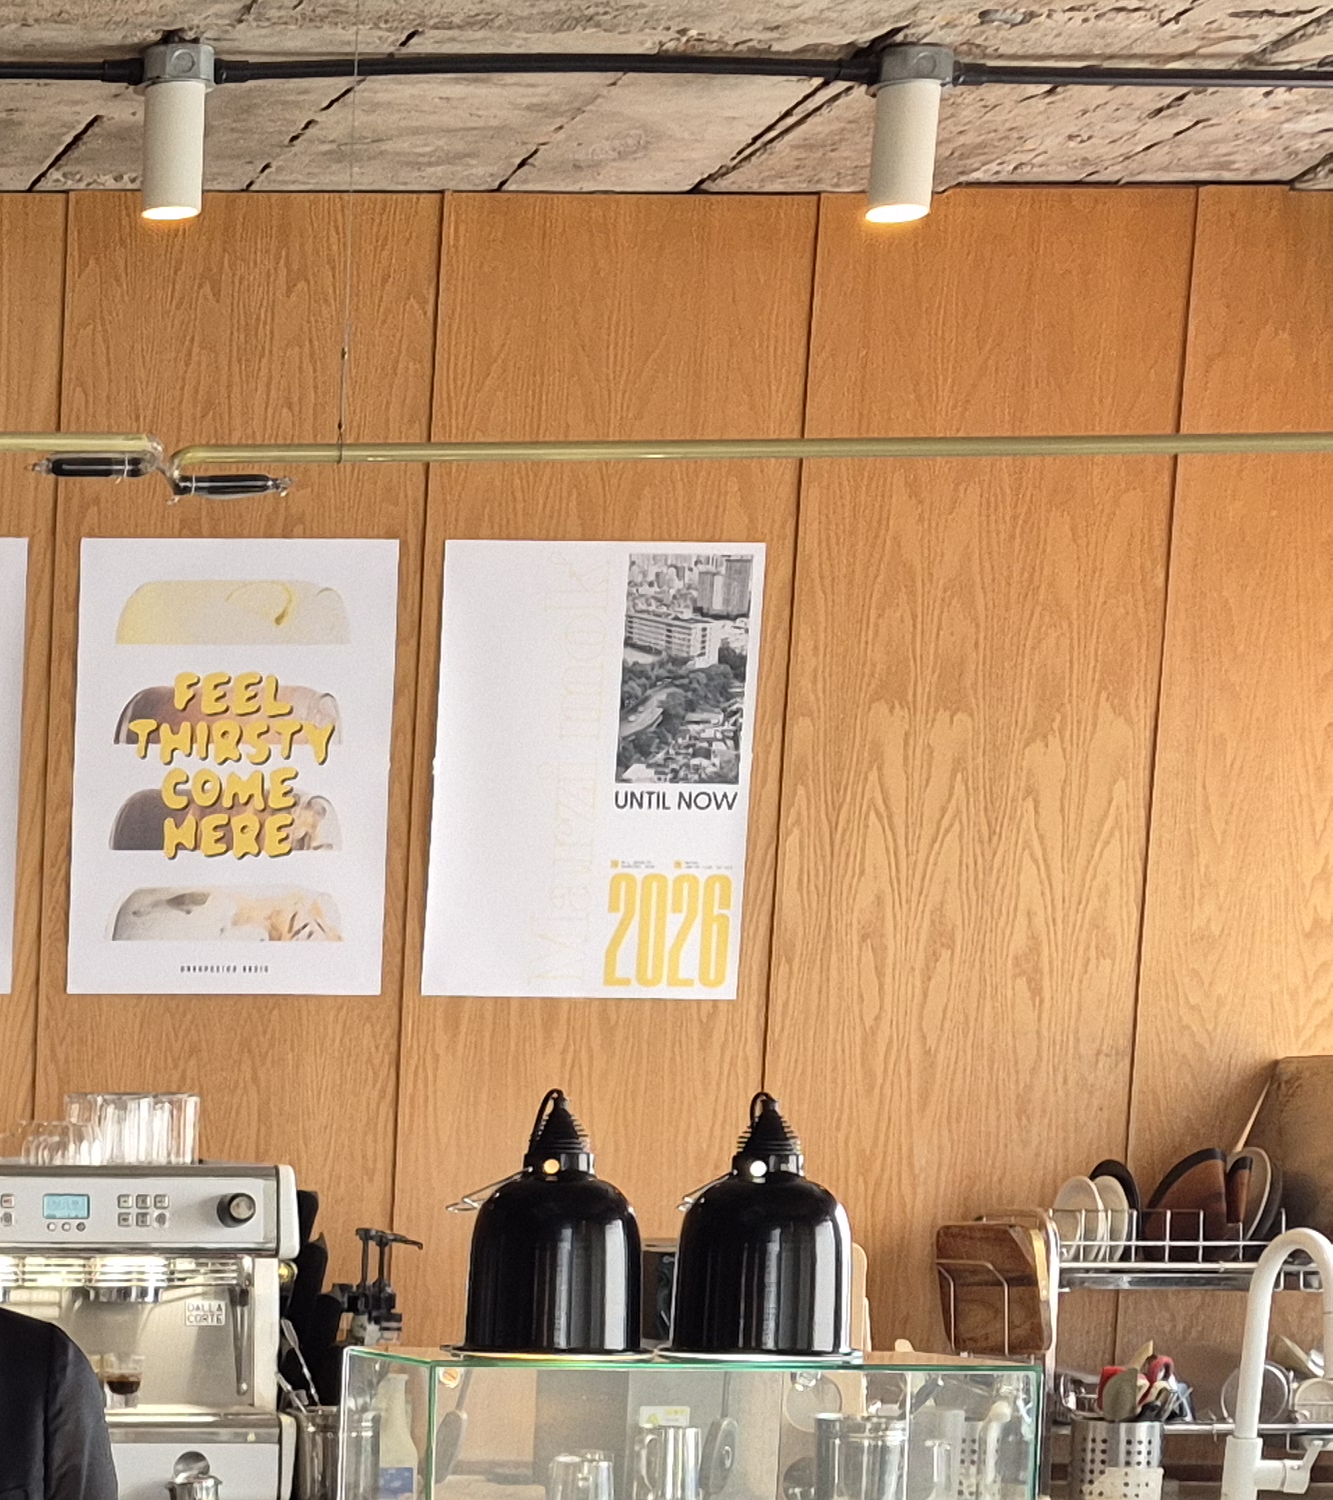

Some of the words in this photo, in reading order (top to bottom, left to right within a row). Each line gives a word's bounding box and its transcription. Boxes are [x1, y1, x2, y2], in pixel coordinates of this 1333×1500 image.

[173, 671, 292, 716] FEEL
[127, 719, 335, 765] THIRSTY
[161, 766, 298, 810] COME
[614, 790, 671, 811] UNTIL
[677, 791, 738, 811] NOW
[163, 813, 295, 860] HERE
[603, 872, 732, 988] 2026
[187, 1302, 223, 1312] DALLA
[187, 1313, 223, 1324] CORTE
